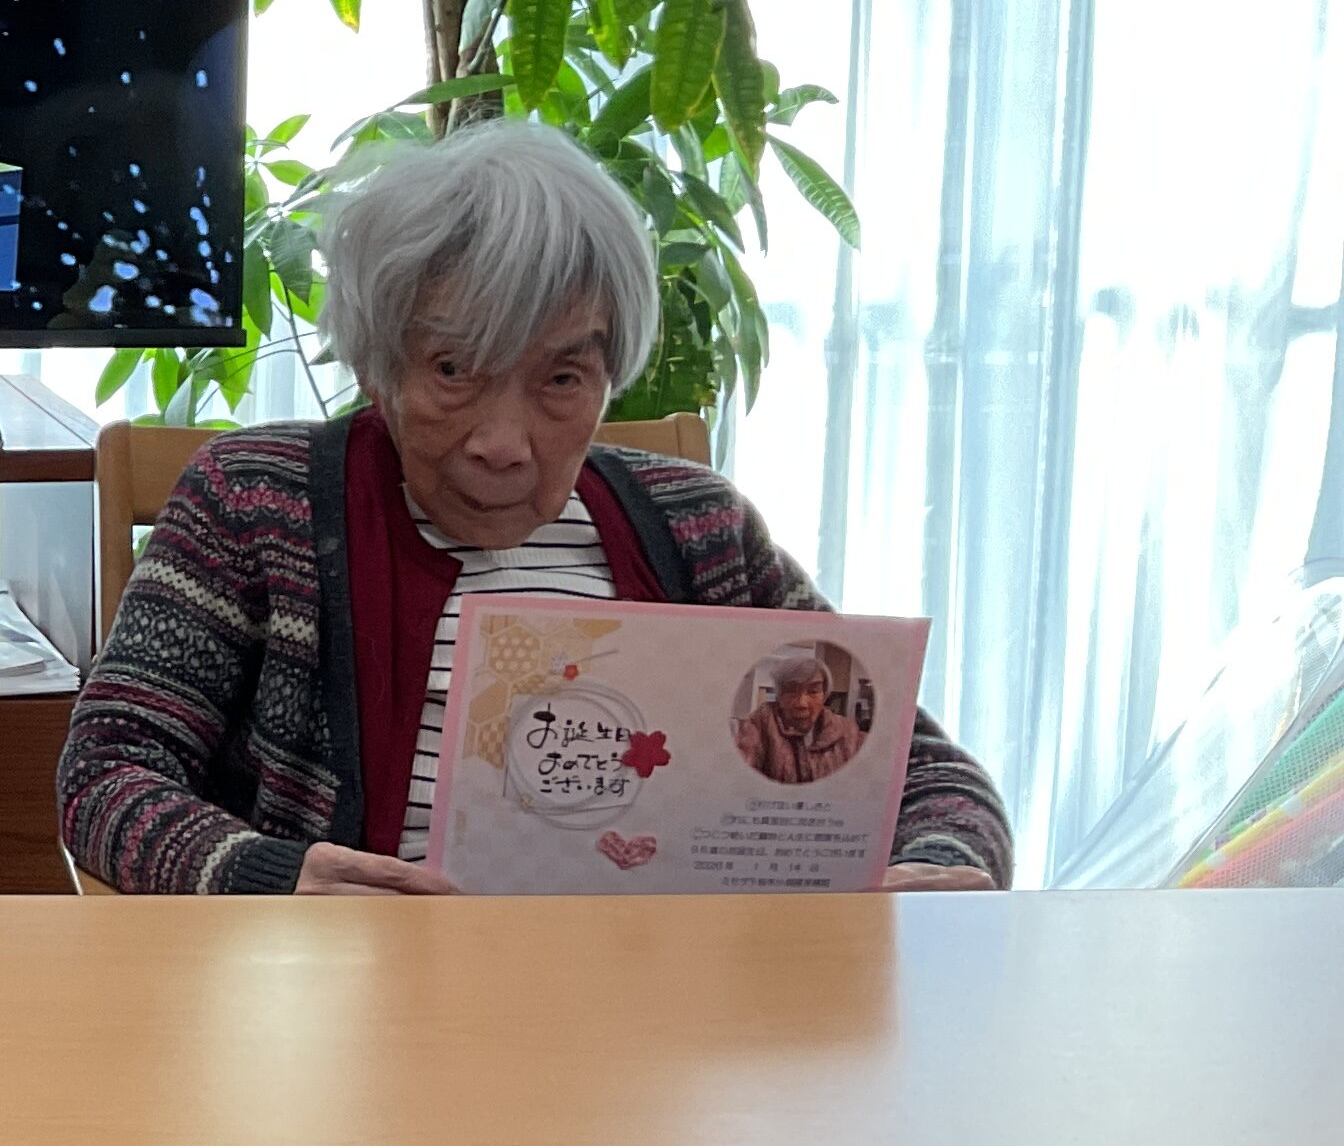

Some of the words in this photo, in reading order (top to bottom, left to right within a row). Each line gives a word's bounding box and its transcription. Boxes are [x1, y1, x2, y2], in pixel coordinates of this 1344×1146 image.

[526, 702, 631, 749] お誕生日
[538, 751, 624, 775] おめでとう
[540, 775, 631, 797] ございます
